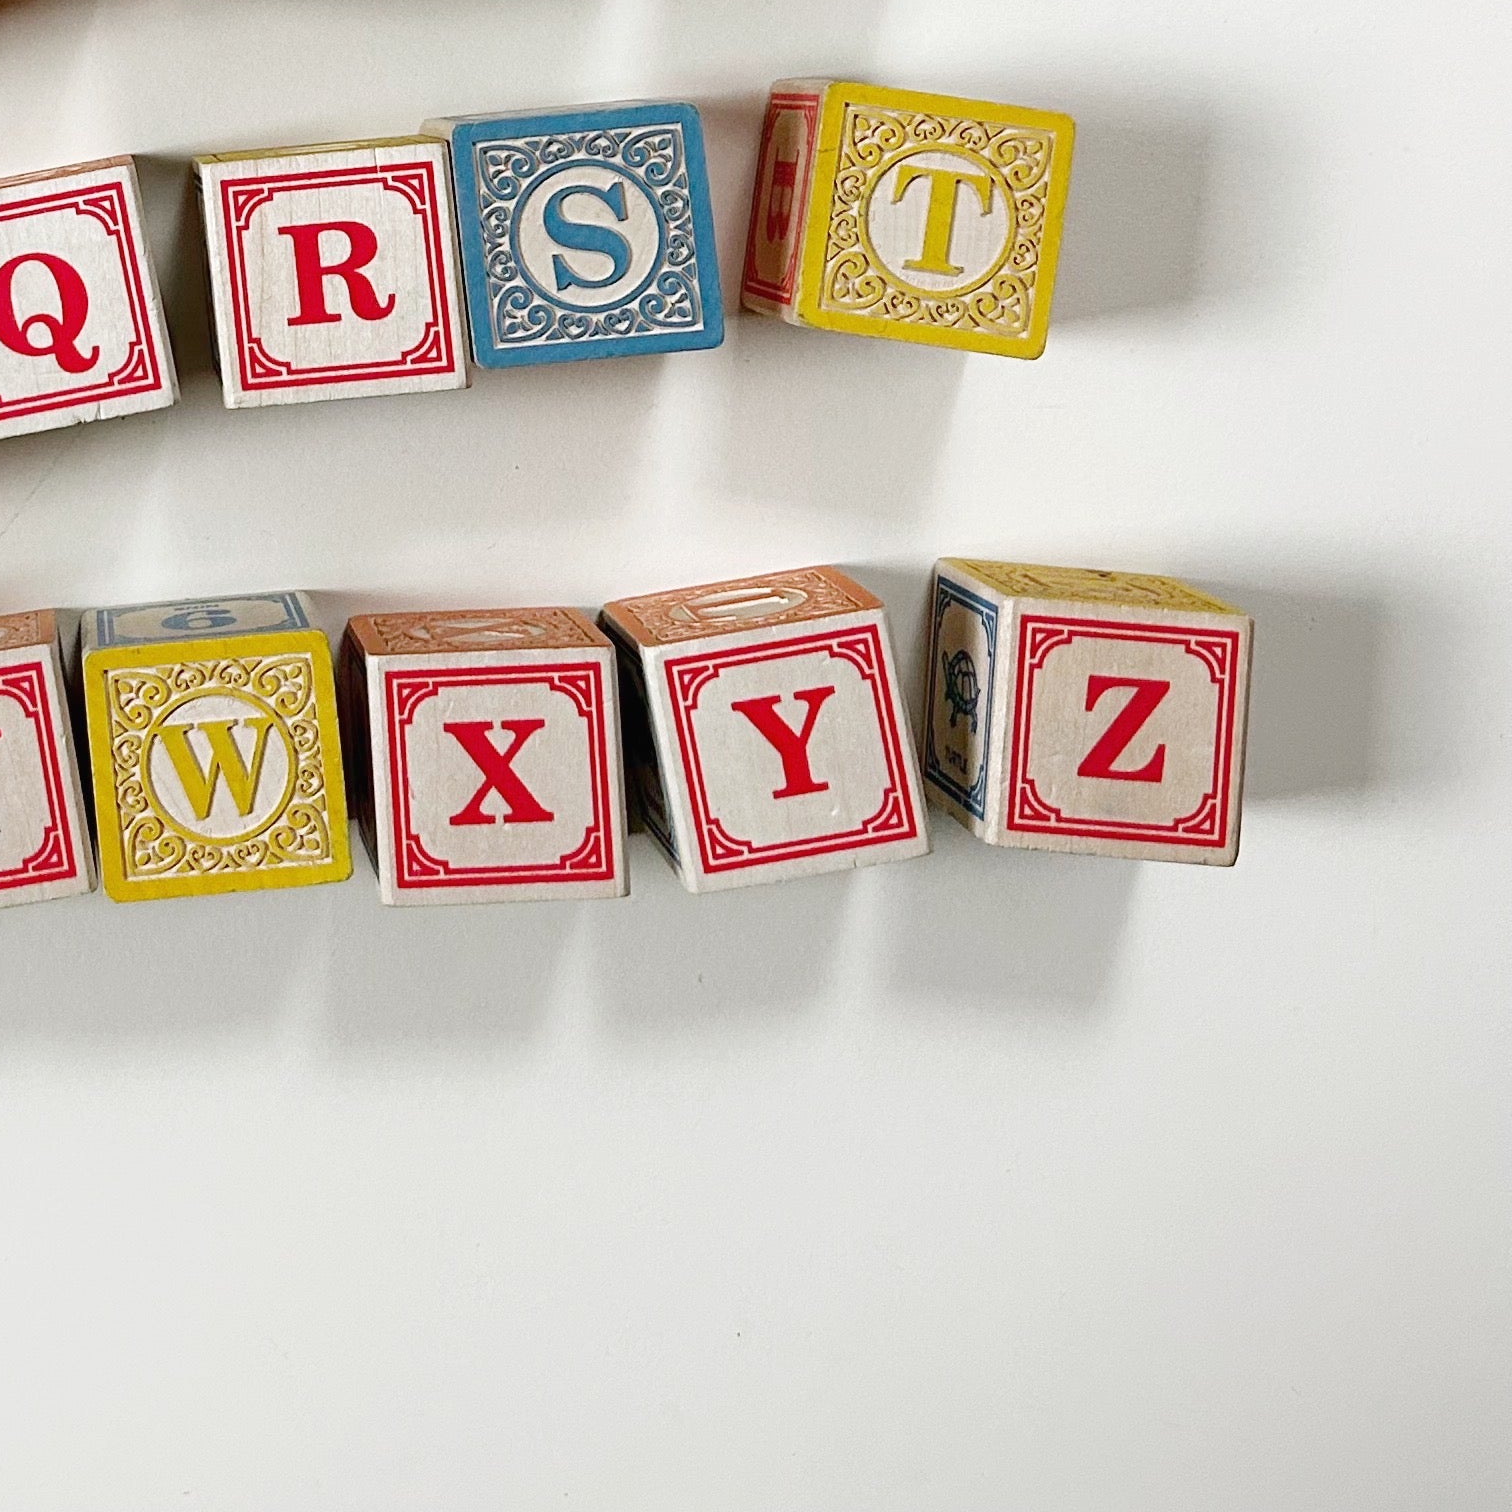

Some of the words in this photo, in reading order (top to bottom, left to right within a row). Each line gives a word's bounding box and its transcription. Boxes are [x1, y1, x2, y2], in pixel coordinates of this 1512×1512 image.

[276, 220, 397, 327] R
[542, 180, 633, 292] S
[891, 164, 995, 277] T
[155, 715, 274, 821] W
[442, 717, 555, 828] X
[730, 684, 836, 801] Y
[1076, 673, 1171, 785] Z
